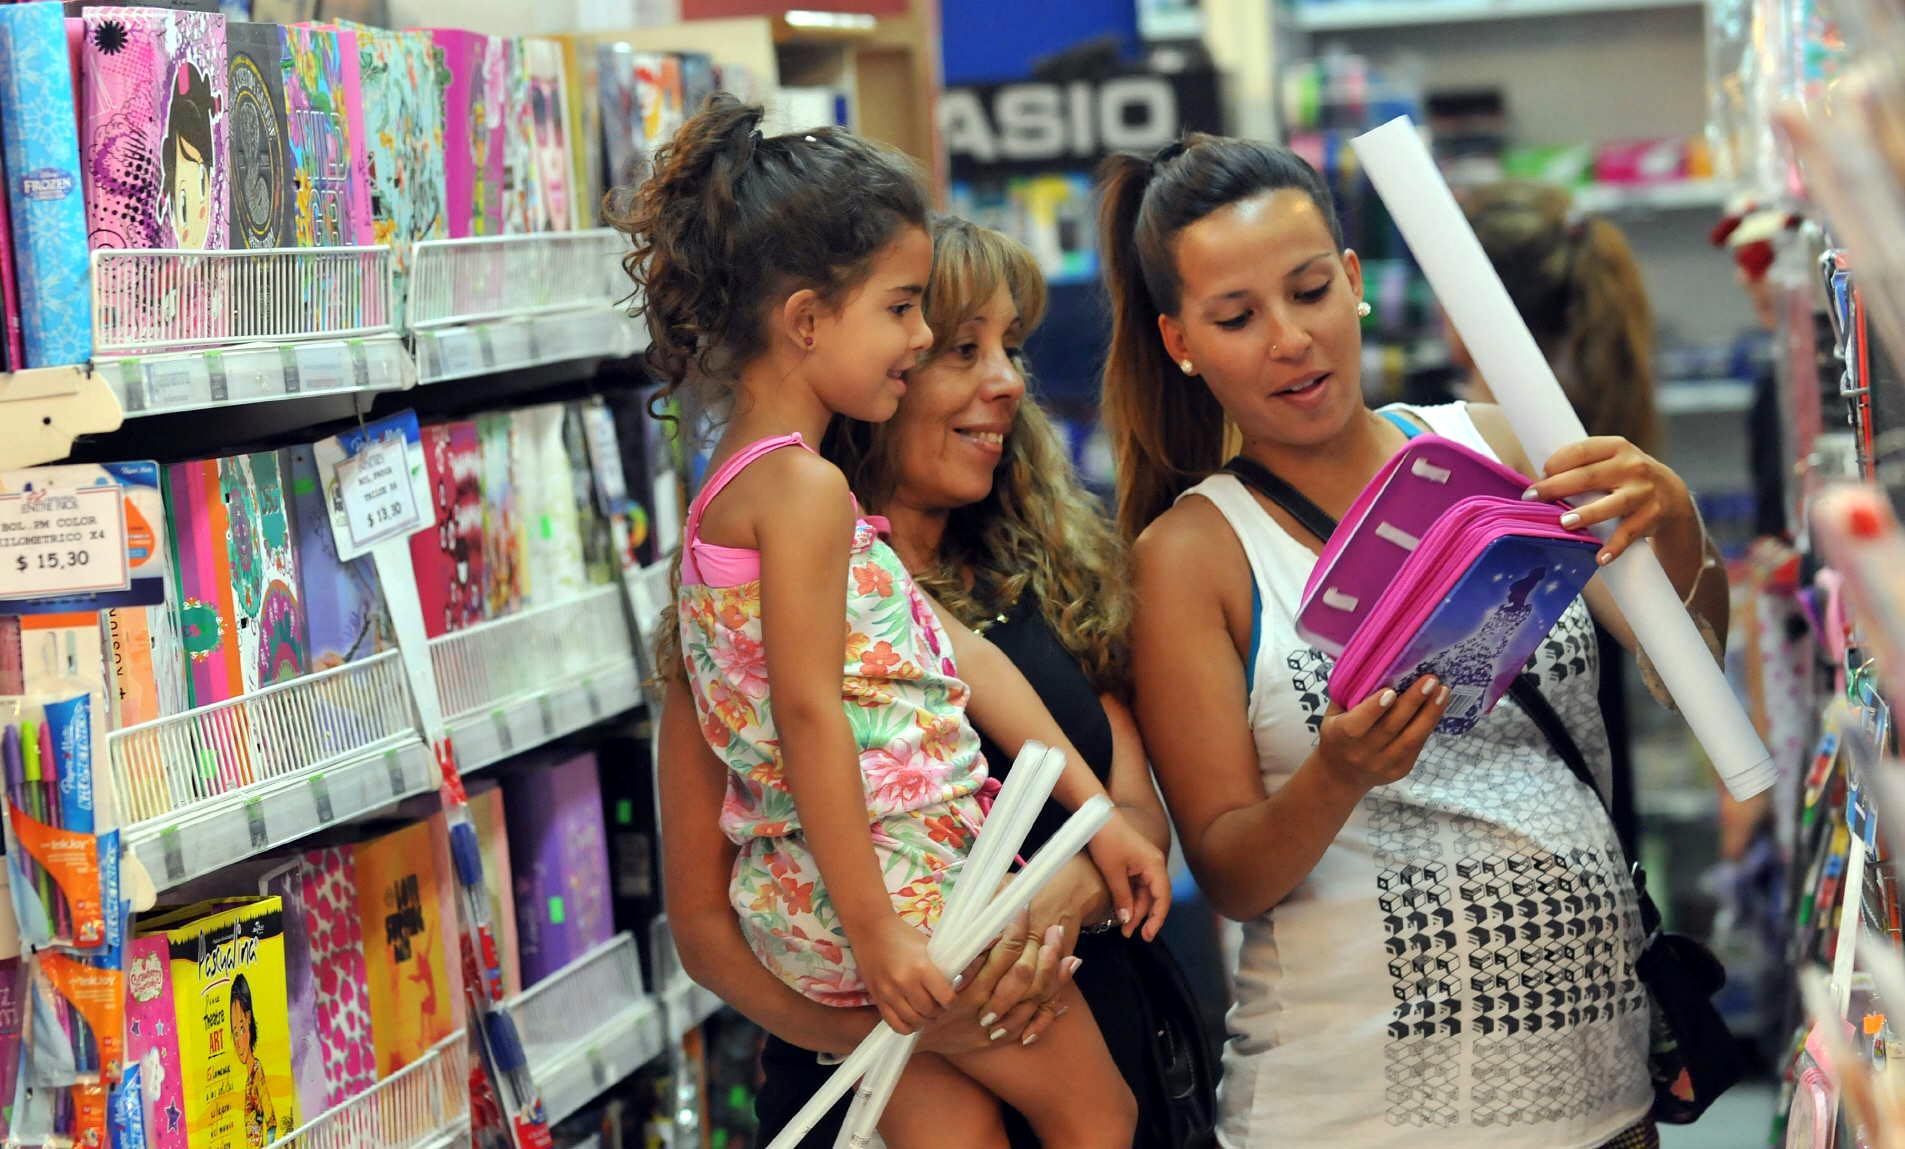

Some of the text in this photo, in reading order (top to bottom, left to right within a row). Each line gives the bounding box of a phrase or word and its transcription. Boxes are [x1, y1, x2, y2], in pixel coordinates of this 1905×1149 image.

[24, 177, 72, 194] FROZEN
[56, 516, 97, 529] COLOR
[368, 512, 375, 528] $
[89, 530, 106, 541] X4
[16, 550, 90, 572] $ 15,30
[197, 916, 259, 983] Pasqualina
[208, 1028, 224, 1054] ART
